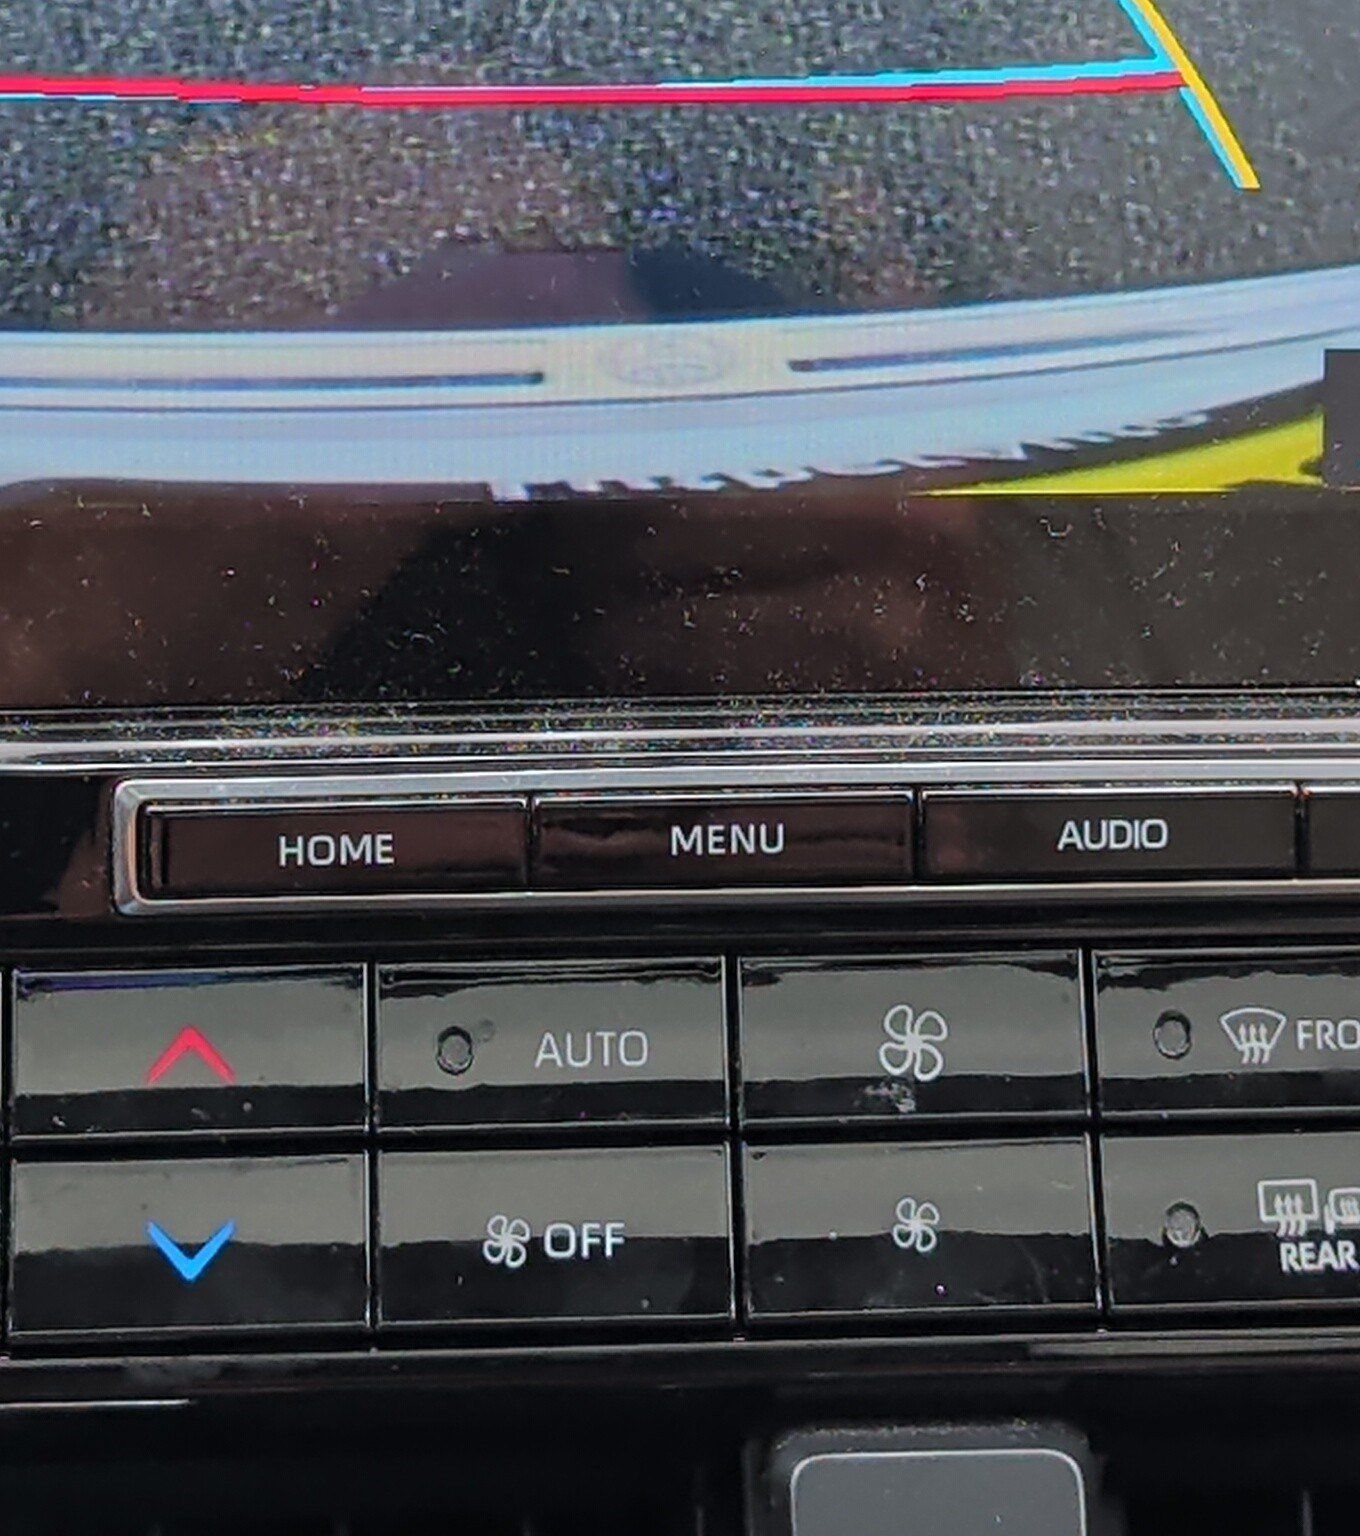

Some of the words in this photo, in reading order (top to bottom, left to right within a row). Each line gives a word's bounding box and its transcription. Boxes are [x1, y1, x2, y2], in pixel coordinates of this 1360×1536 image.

[278, 833, 395, 866] HOME
[670, 822, 785, 856] MENU
[1056, 818, 1169, 850] AUDIO
[534, 1030, 649, 1068] AUTO
[543, 1220, 626, 1259] OFF
[1278, 1239, 1360, 1273] REAR
